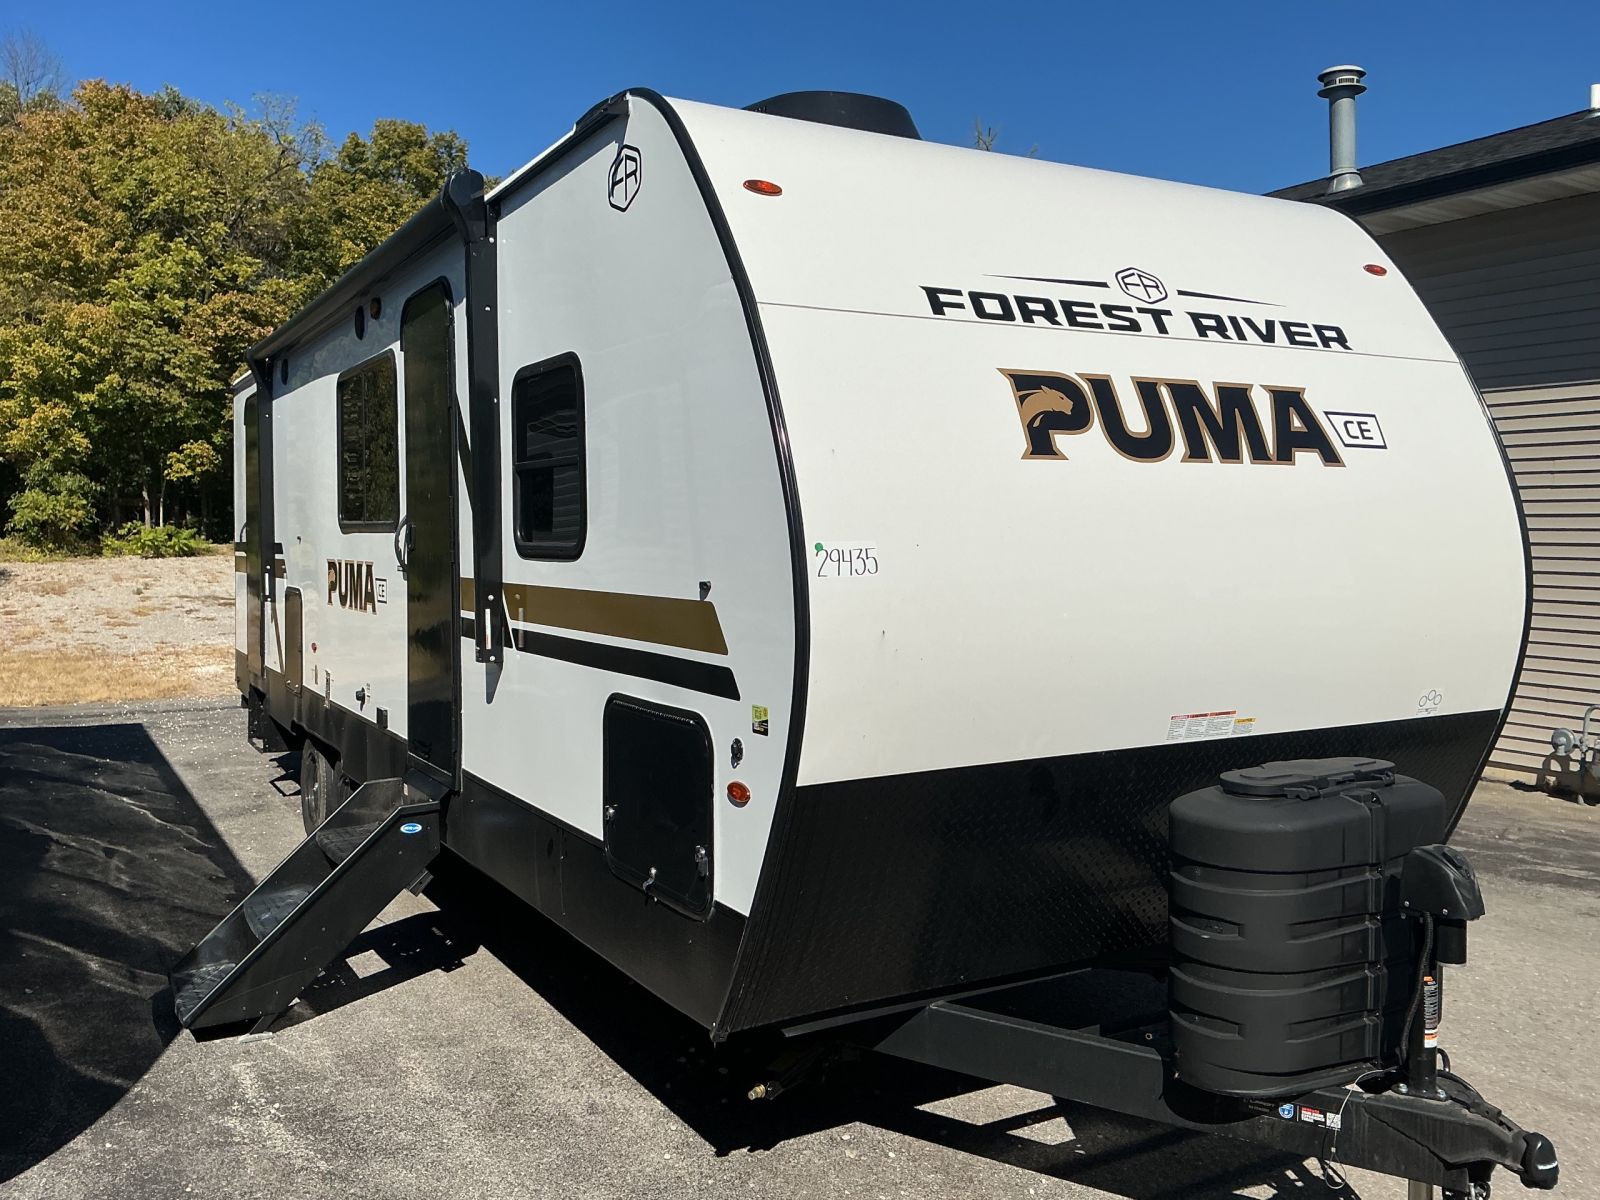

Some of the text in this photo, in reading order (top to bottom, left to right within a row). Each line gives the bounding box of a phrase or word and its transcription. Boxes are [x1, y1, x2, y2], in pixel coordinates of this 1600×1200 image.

[1121, 272, 1164, 299] FR
[920, 285, 1354, 351] FOREST RIVER
[996, 367, 1375, 468] PUMA CE
[327, 559, 377, 615] PUMA
[815, 547, 879, 577] 29435
